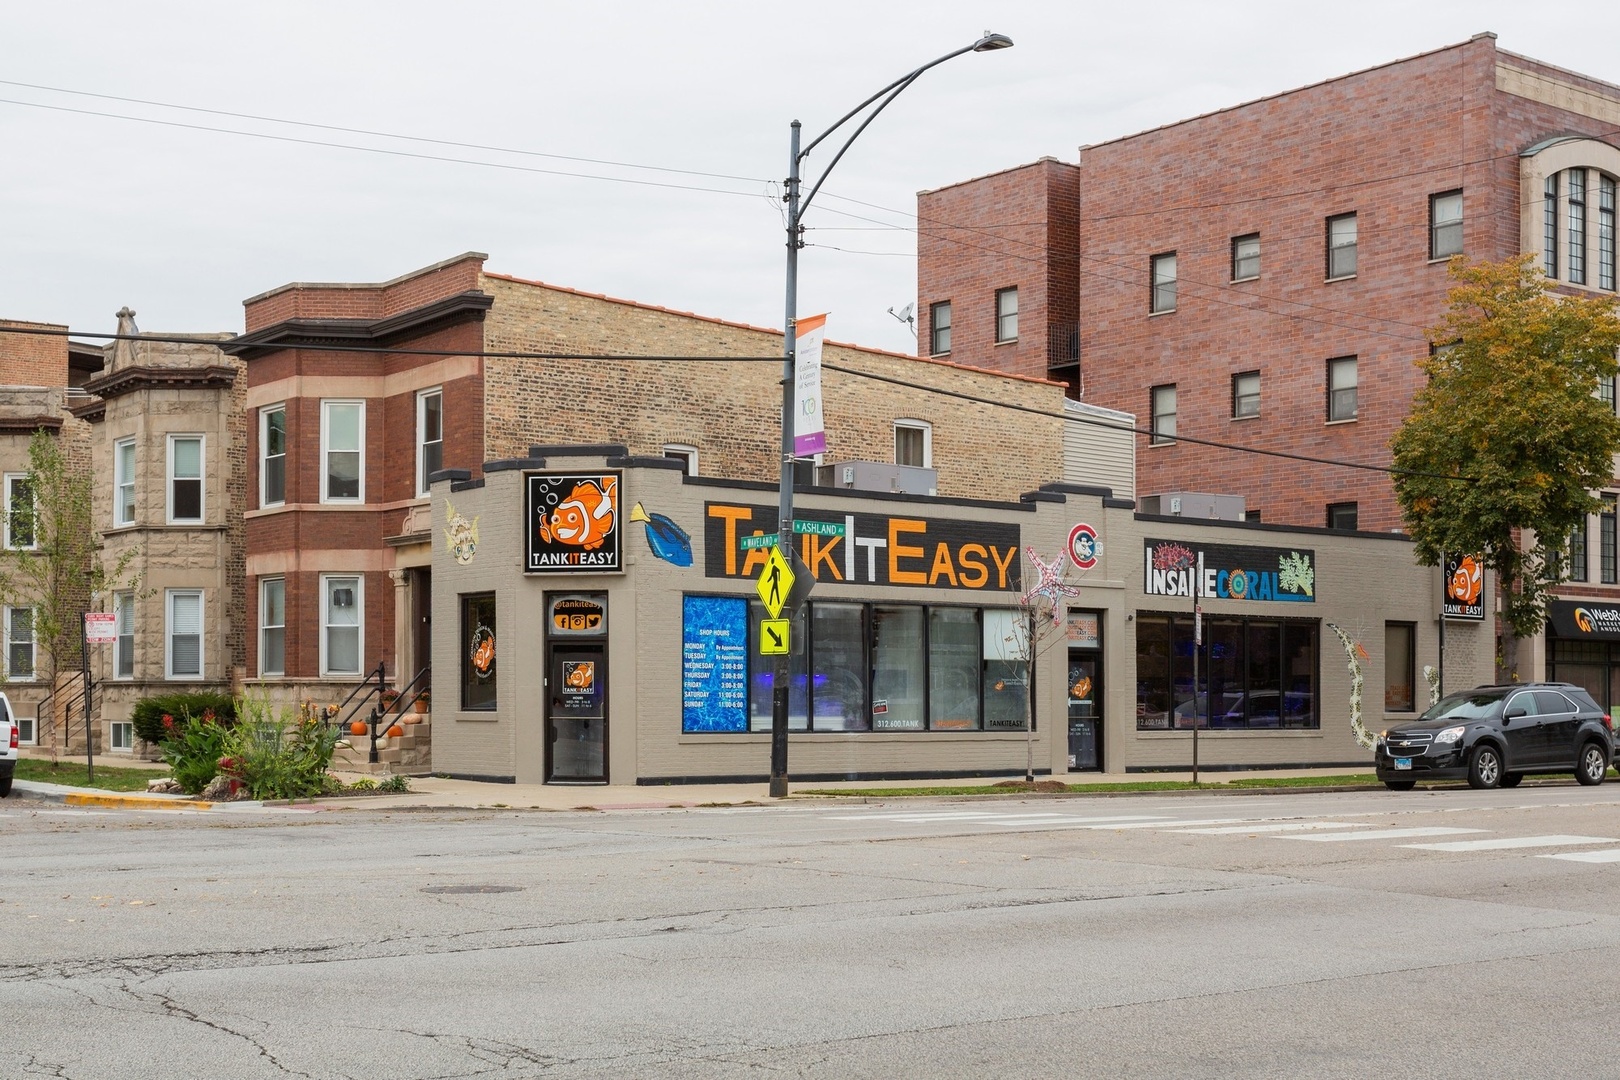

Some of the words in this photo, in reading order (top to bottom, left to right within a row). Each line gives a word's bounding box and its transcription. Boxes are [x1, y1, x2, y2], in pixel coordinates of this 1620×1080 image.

[802, 522, 836, 534] ASHLAND
[747, 536, 772, 547] WAVELAND
[533, 552, 614, 565] TANKITEASY
[1590, 608, 1620, 620] WebR
